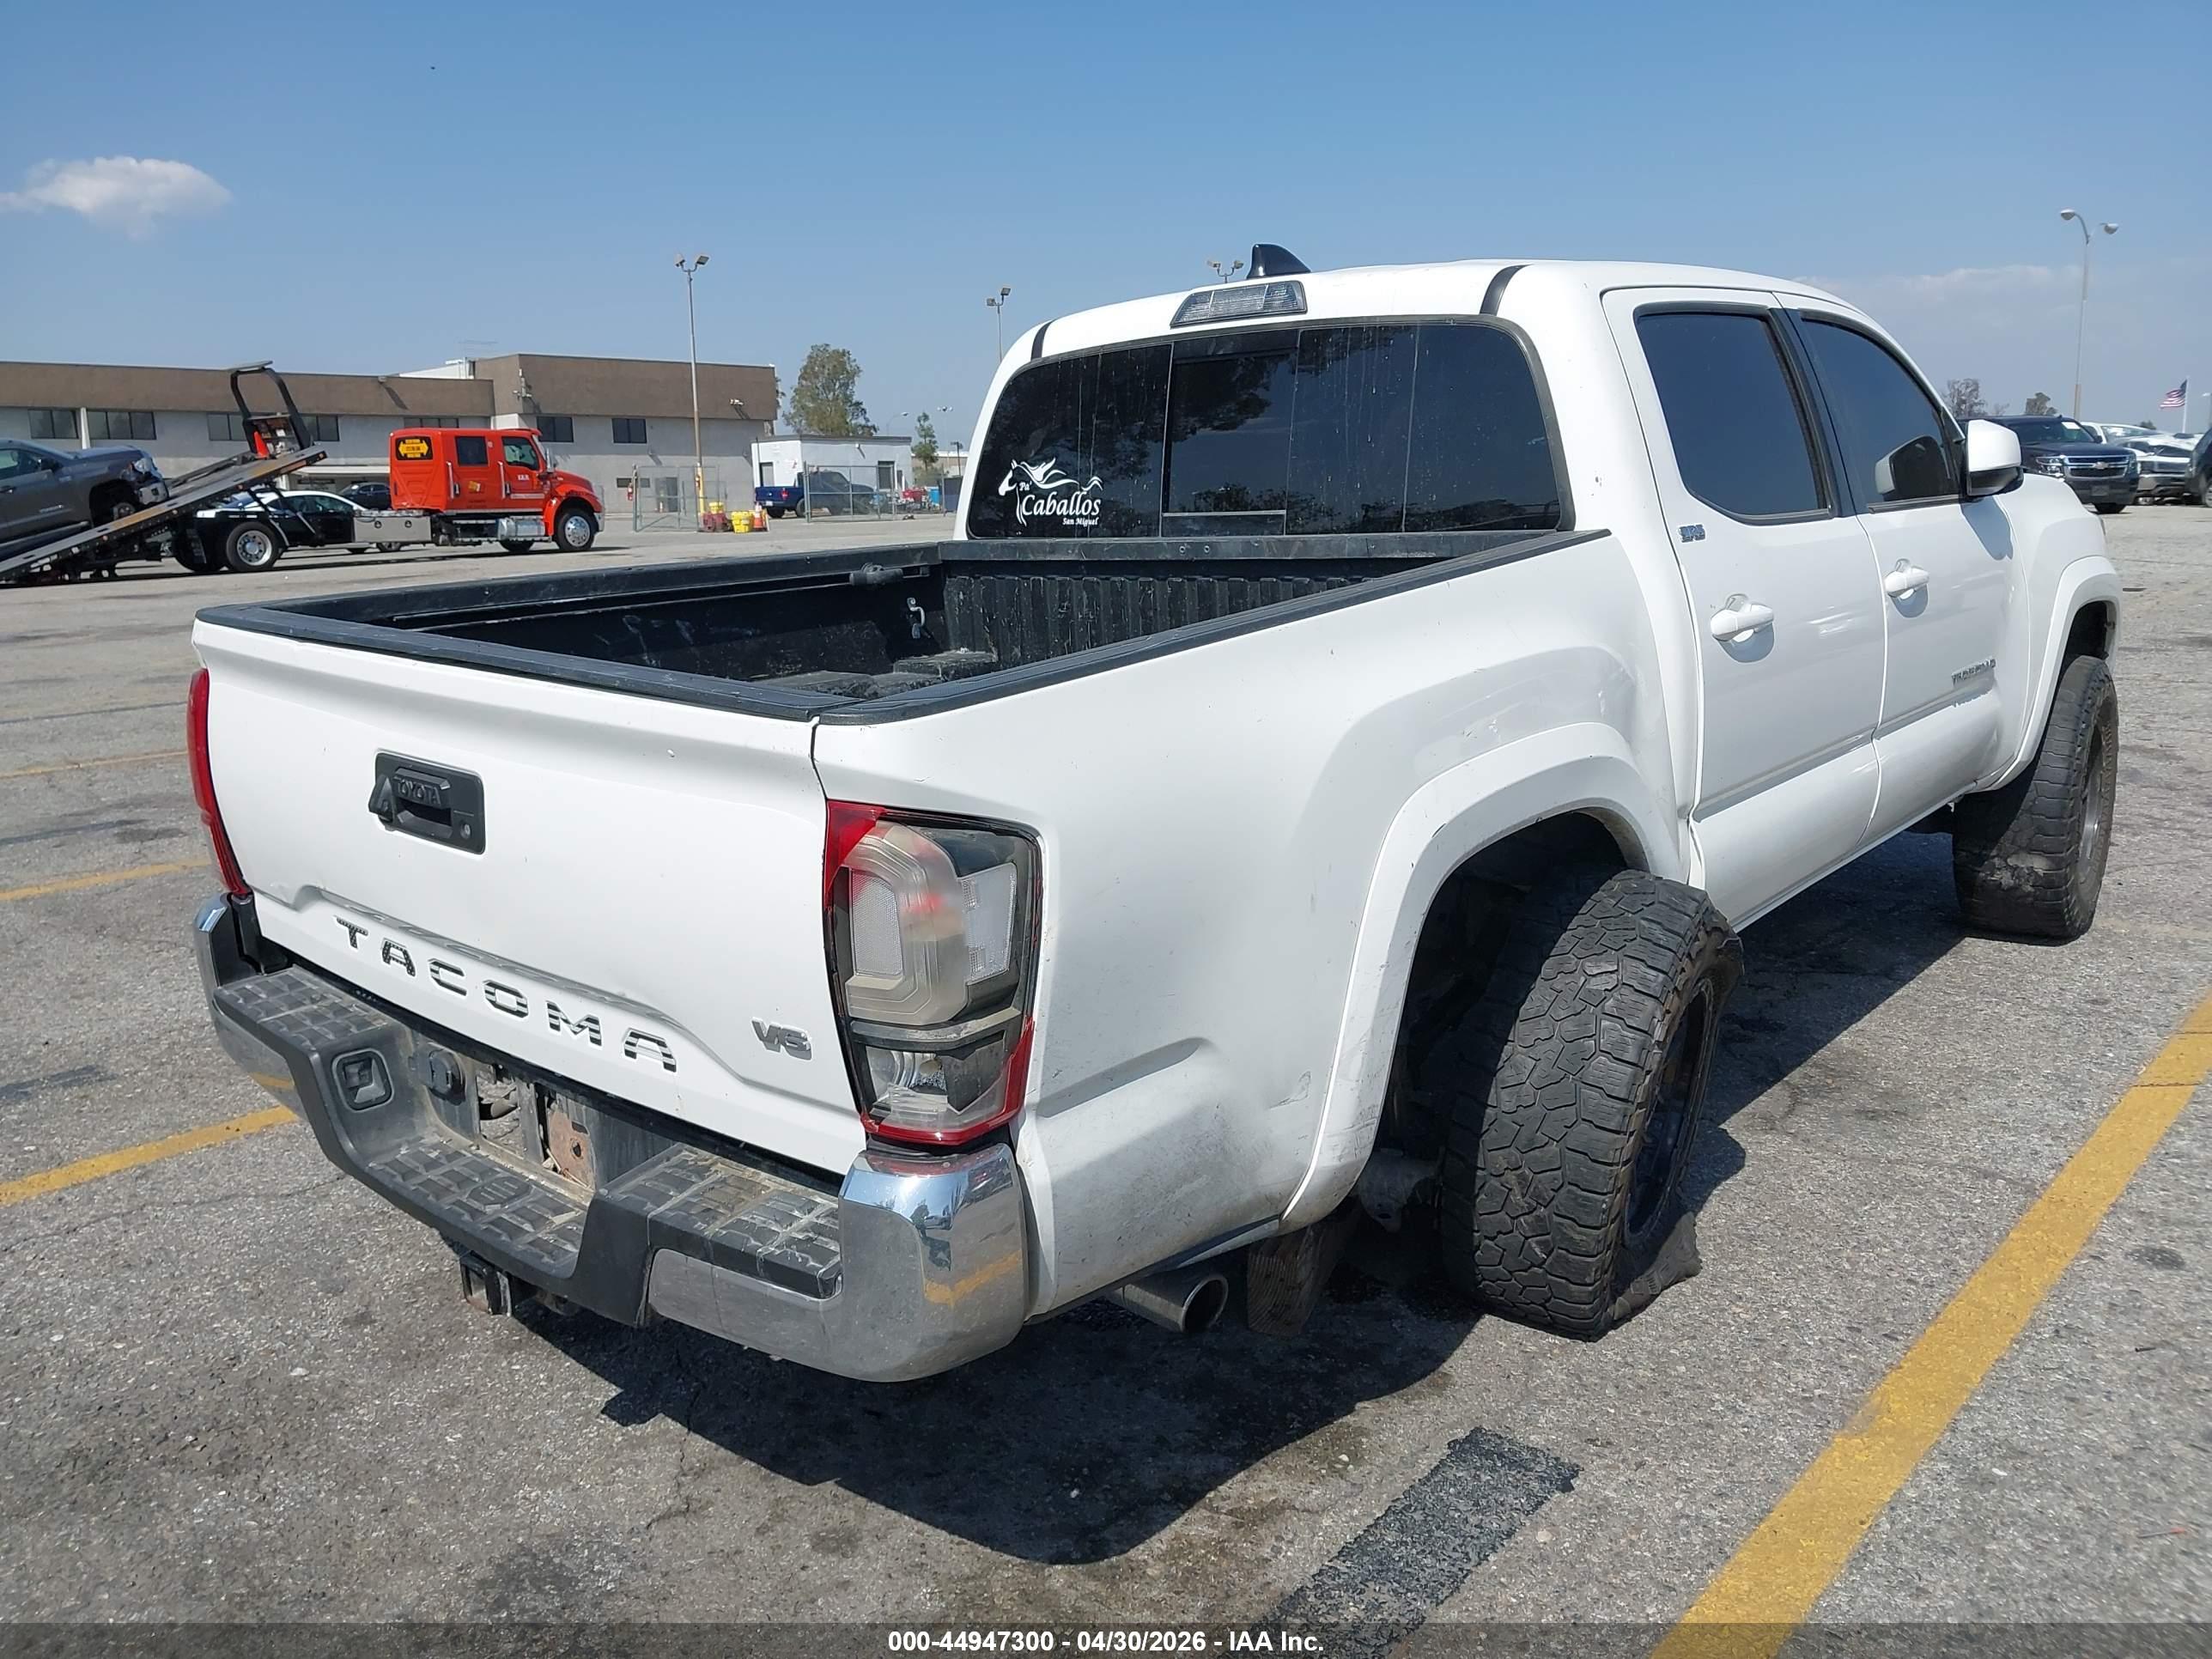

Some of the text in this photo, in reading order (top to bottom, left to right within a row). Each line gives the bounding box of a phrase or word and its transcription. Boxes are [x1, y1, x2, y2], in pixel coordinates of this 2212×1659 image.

[1022, 491, 1102, 516] Caballos
[1062, 517, 1100, 527] San Miguel
[334, 915, 678, 1073] TACOMA
[751, 1018, 812, 1060] V6
